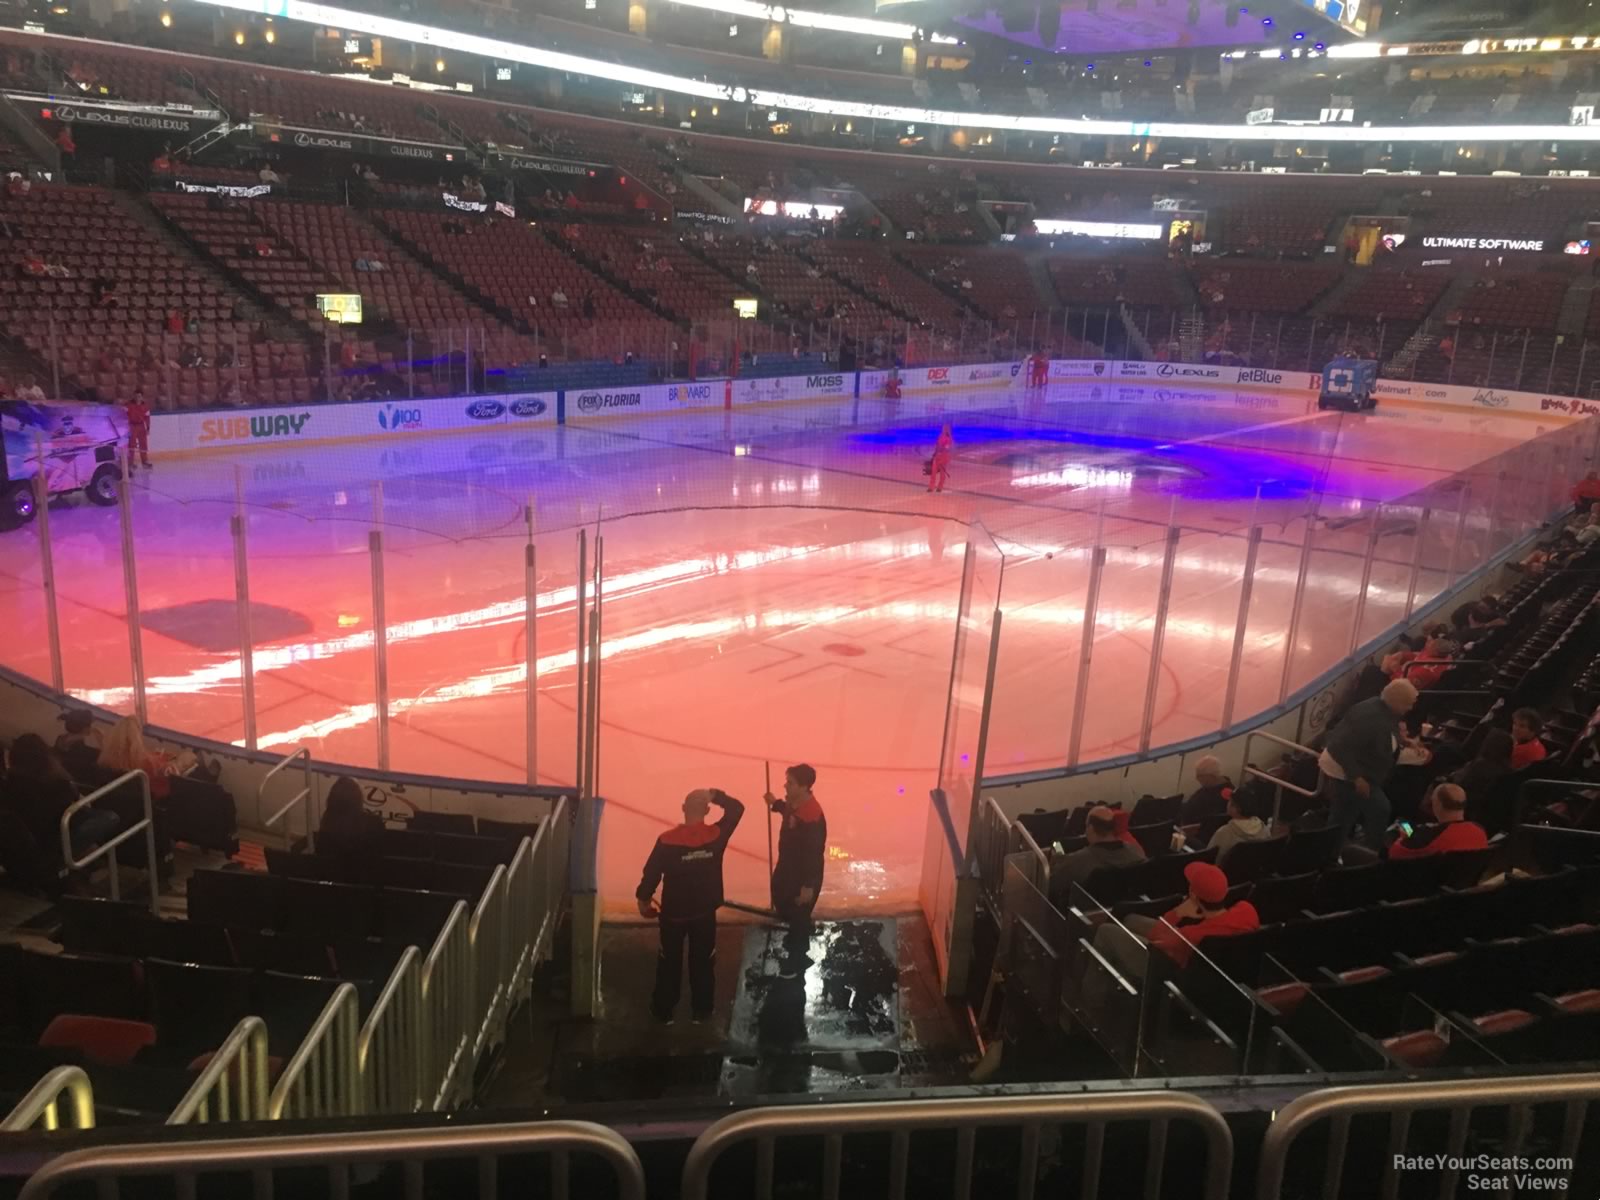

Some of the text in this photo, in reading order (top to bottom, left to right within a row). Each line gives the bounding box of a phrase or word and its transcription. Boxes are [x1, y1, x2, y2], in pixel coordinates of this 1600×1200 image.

[76, 111, 129, 125] LEXUS
[309, 138, 352, 149] LEXUS
[1422, 237, 1544, 250] ULTIMATE SOFTWARE
[927, 368, 949, 380] DEX
[1175, 368, 1220, 378] LEXUS
[1236, 367, 1283, 384] jetBlue
[582, 395, 600, 408] FOX
[603, 393, 640, 407] FLORIDA
[198, 412, 311, 442] SUBWAY
